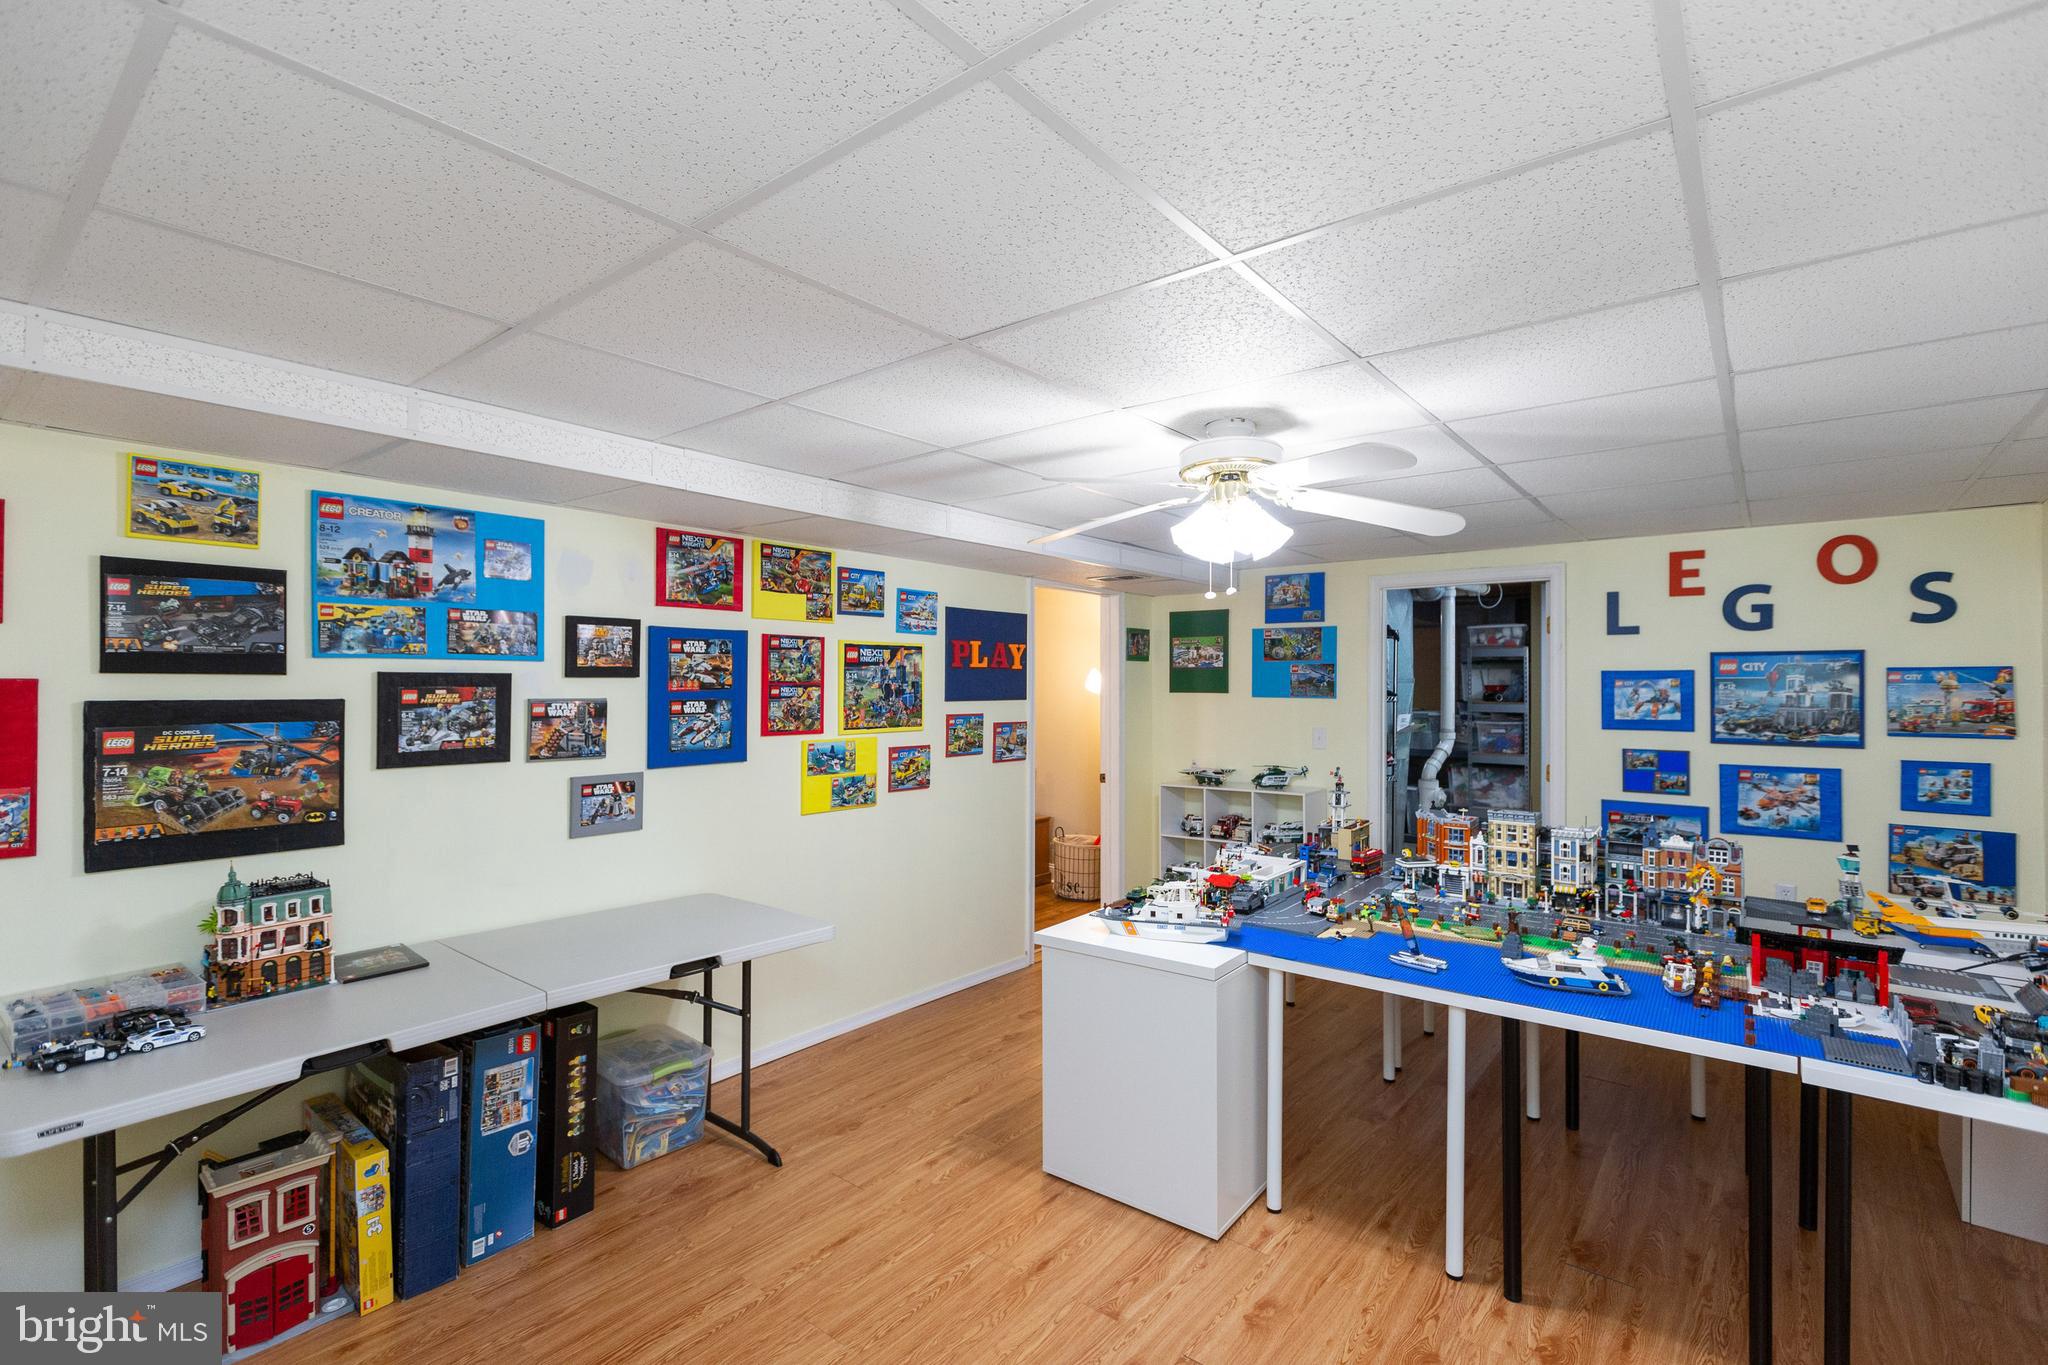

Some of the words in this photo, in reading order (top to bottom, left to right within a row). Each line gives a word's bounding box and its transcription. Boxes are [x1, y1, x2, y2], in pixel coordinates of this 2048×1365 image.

[321, 504, 342, 513] LEGO
[348, 507, 402, 520] CREATOR
[320, 524, 340, 532] 8-12
[137, 589, 192, 597] HEROES
[683, 644, 707, 653] WARS
[951, 640, 1026, 670] PLAY
[1742, 662, 1767, 671] CITY
[547, 707, 577, 717] WARS
[683, 705, 707, 714] WARS
[105, 738, 132, 747] LEGO
[153, 735, 215, 744] SUPER
[143, 742, 216, 751] HEROES
[103, 767, 128, 777] 7-14
